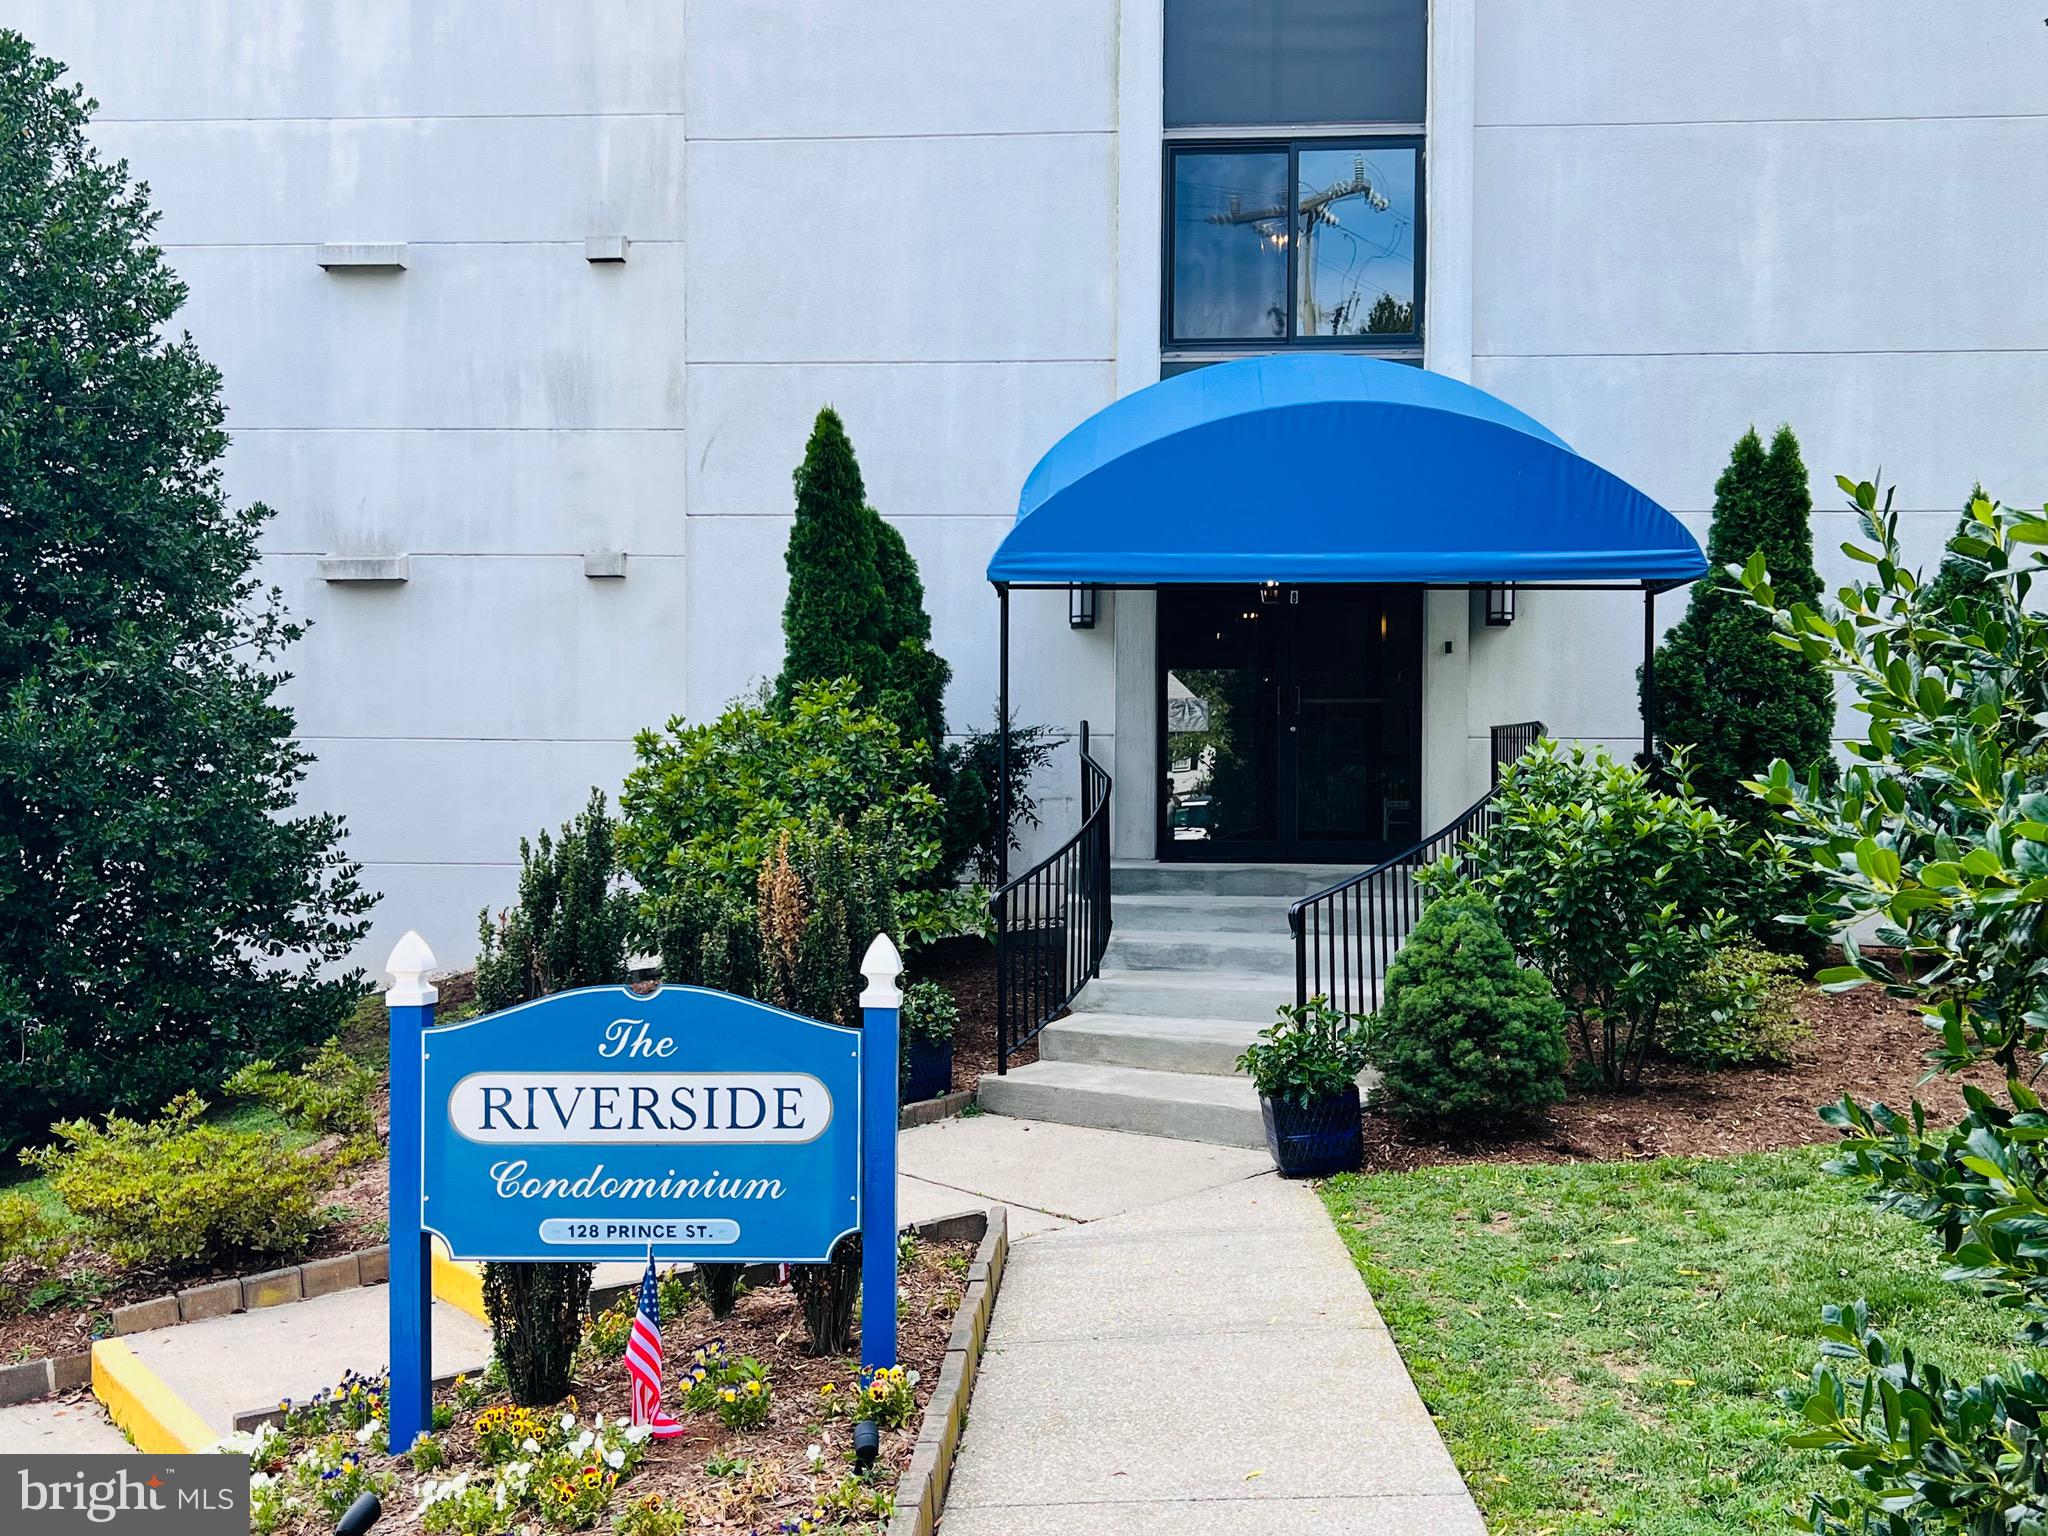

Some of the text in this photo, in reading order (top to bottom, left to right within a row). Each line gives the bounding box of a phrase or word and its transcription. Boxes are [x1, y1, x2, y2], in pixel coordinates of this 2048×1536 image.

[599, 1019, 678, 1058] The
[479, 1086, 806, 1131] RIVERSIDE
[490, 1160, 786, 1199] Condominium
[567, 1224, 713, 1239] 128 PRINCE ST.
